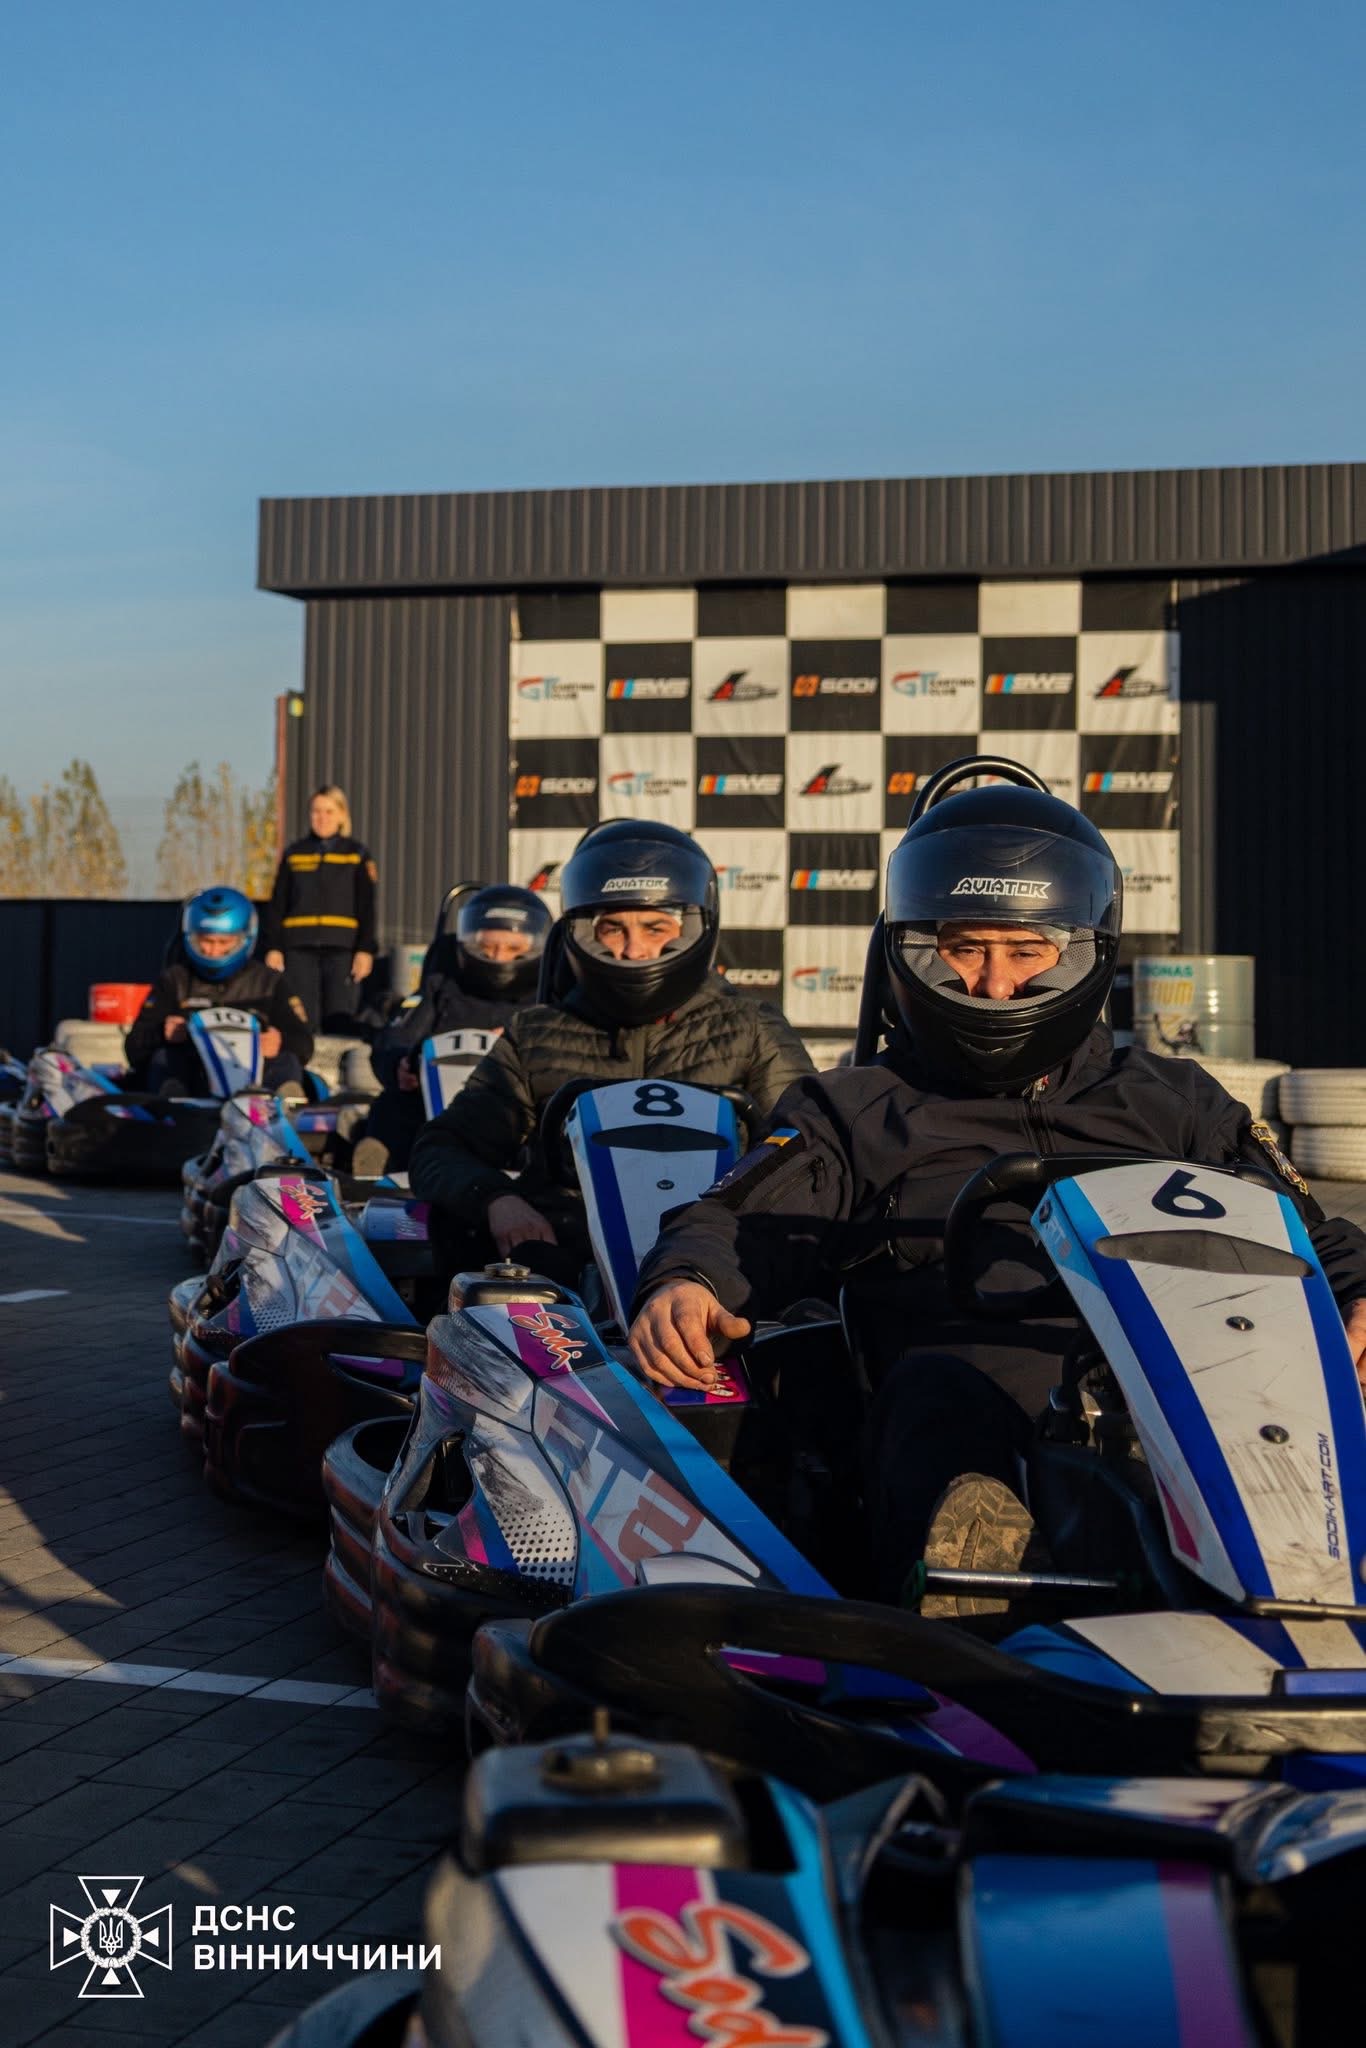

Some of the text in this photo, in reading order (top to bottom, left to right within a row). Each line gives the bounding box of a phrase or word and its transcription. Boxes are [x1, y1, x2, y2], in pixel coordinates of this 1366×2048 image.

[600, 877, 670, 893] AVIATOR
[951, 877, 1052, 899] AVIATOR
[211, 1011, 246, 1025] 10
[448, 1034, 488, 1050] 11
[633, 1083, 685, 1117] 8
[1151, 1168, 1227, 1219] 6
[509, 1311, 588, 1371] Sodi
